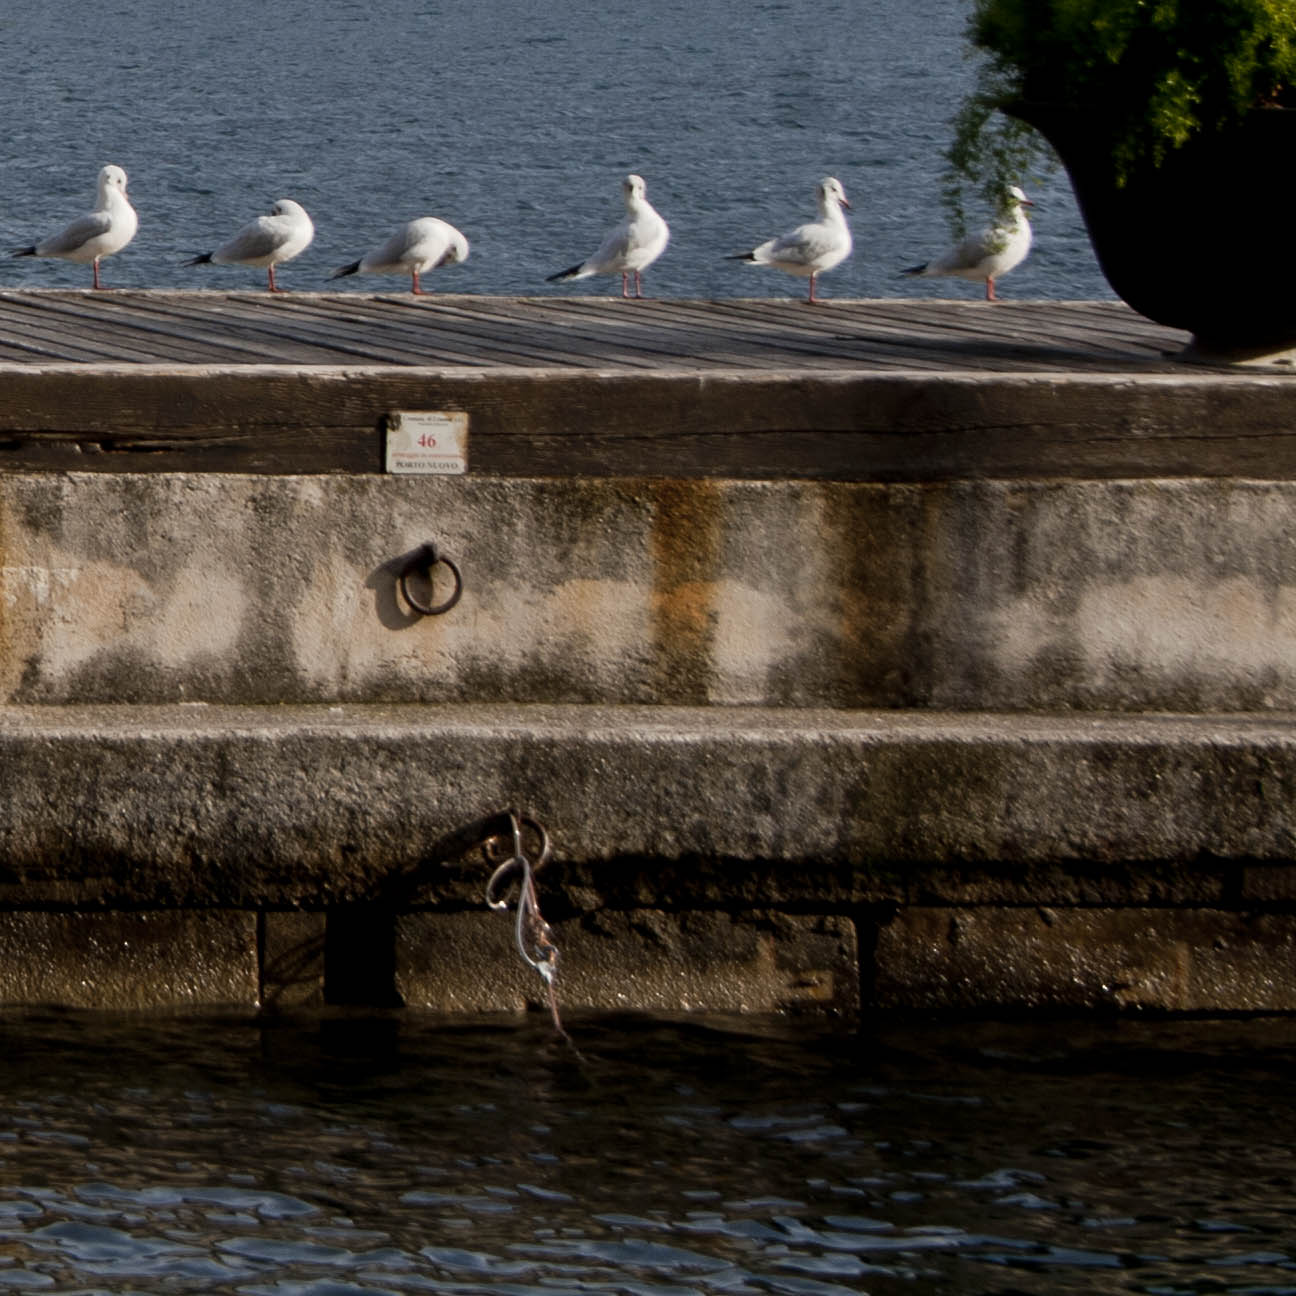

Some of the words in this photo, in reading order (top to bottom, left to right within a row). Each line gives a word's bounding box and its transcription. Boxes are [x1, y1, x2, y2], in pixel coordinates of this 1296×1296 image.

[417, 433, 437, 448] 46
[395, 462, 425, 470] PORTO
[427, 462, 458, 470] NUOVO
